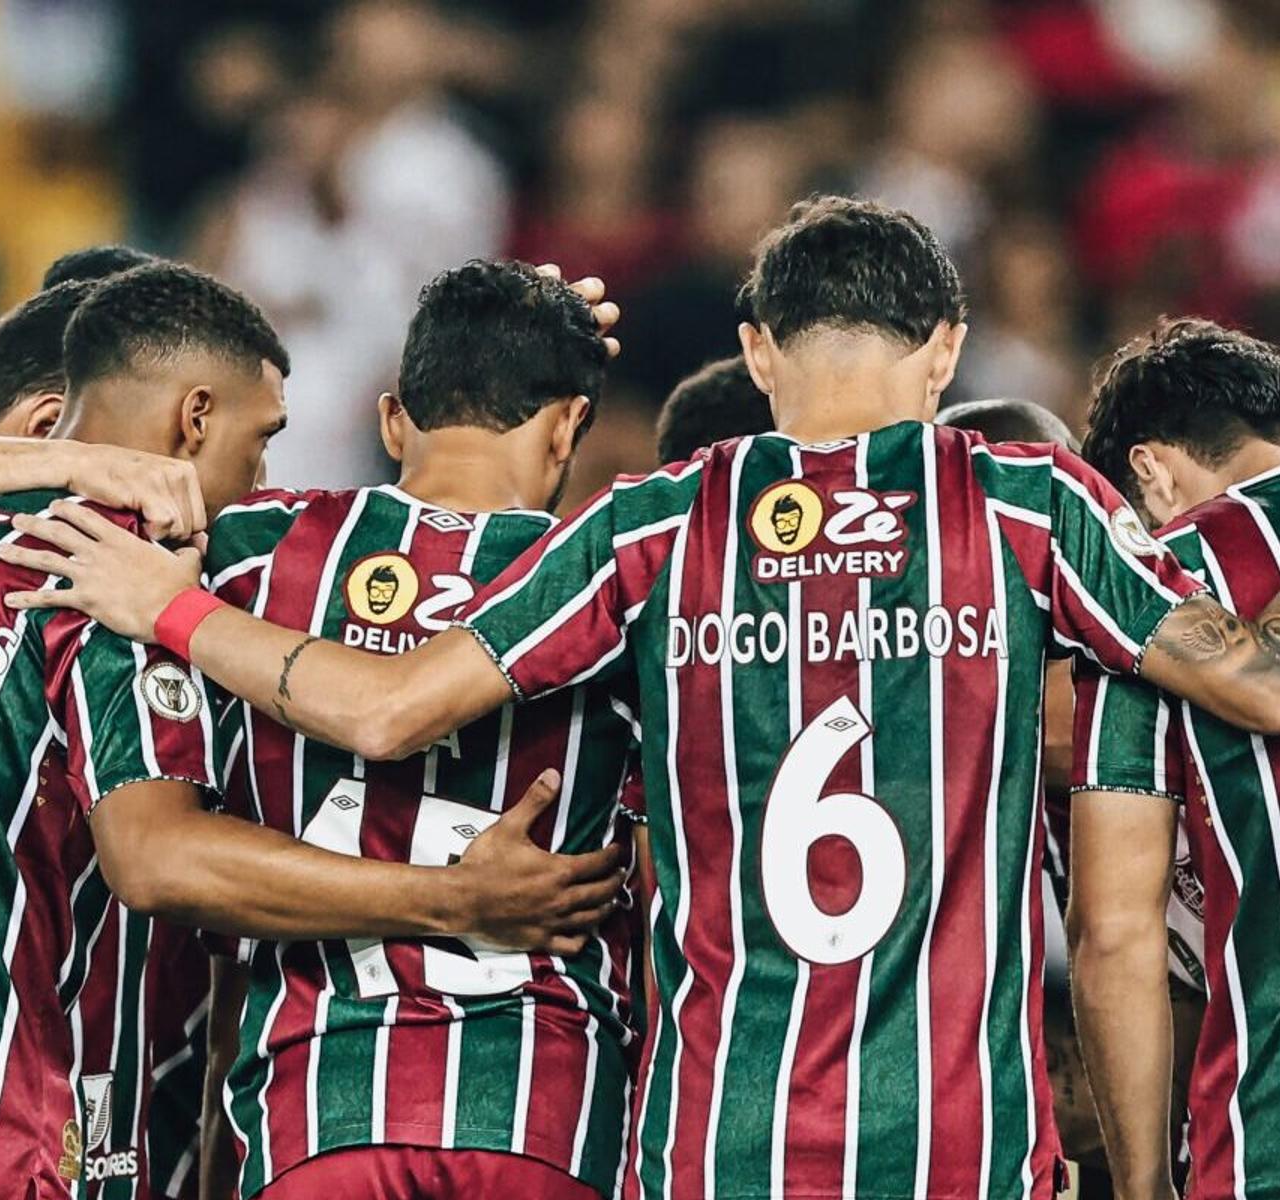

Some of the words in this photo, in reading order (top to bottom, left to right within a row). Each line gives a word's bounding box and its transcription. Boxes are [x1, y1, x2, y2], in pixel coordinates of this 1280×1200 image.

[824, 489, 913, 543] Zé
[757, 550, 905, 579] DELIVERY
[344, 622, 429, 655] DELIV
[666, 611, 788, 668] DIOGO
[806, 603, 1009, 663] BARBOSA
[761, 694, 907, 965] 6
